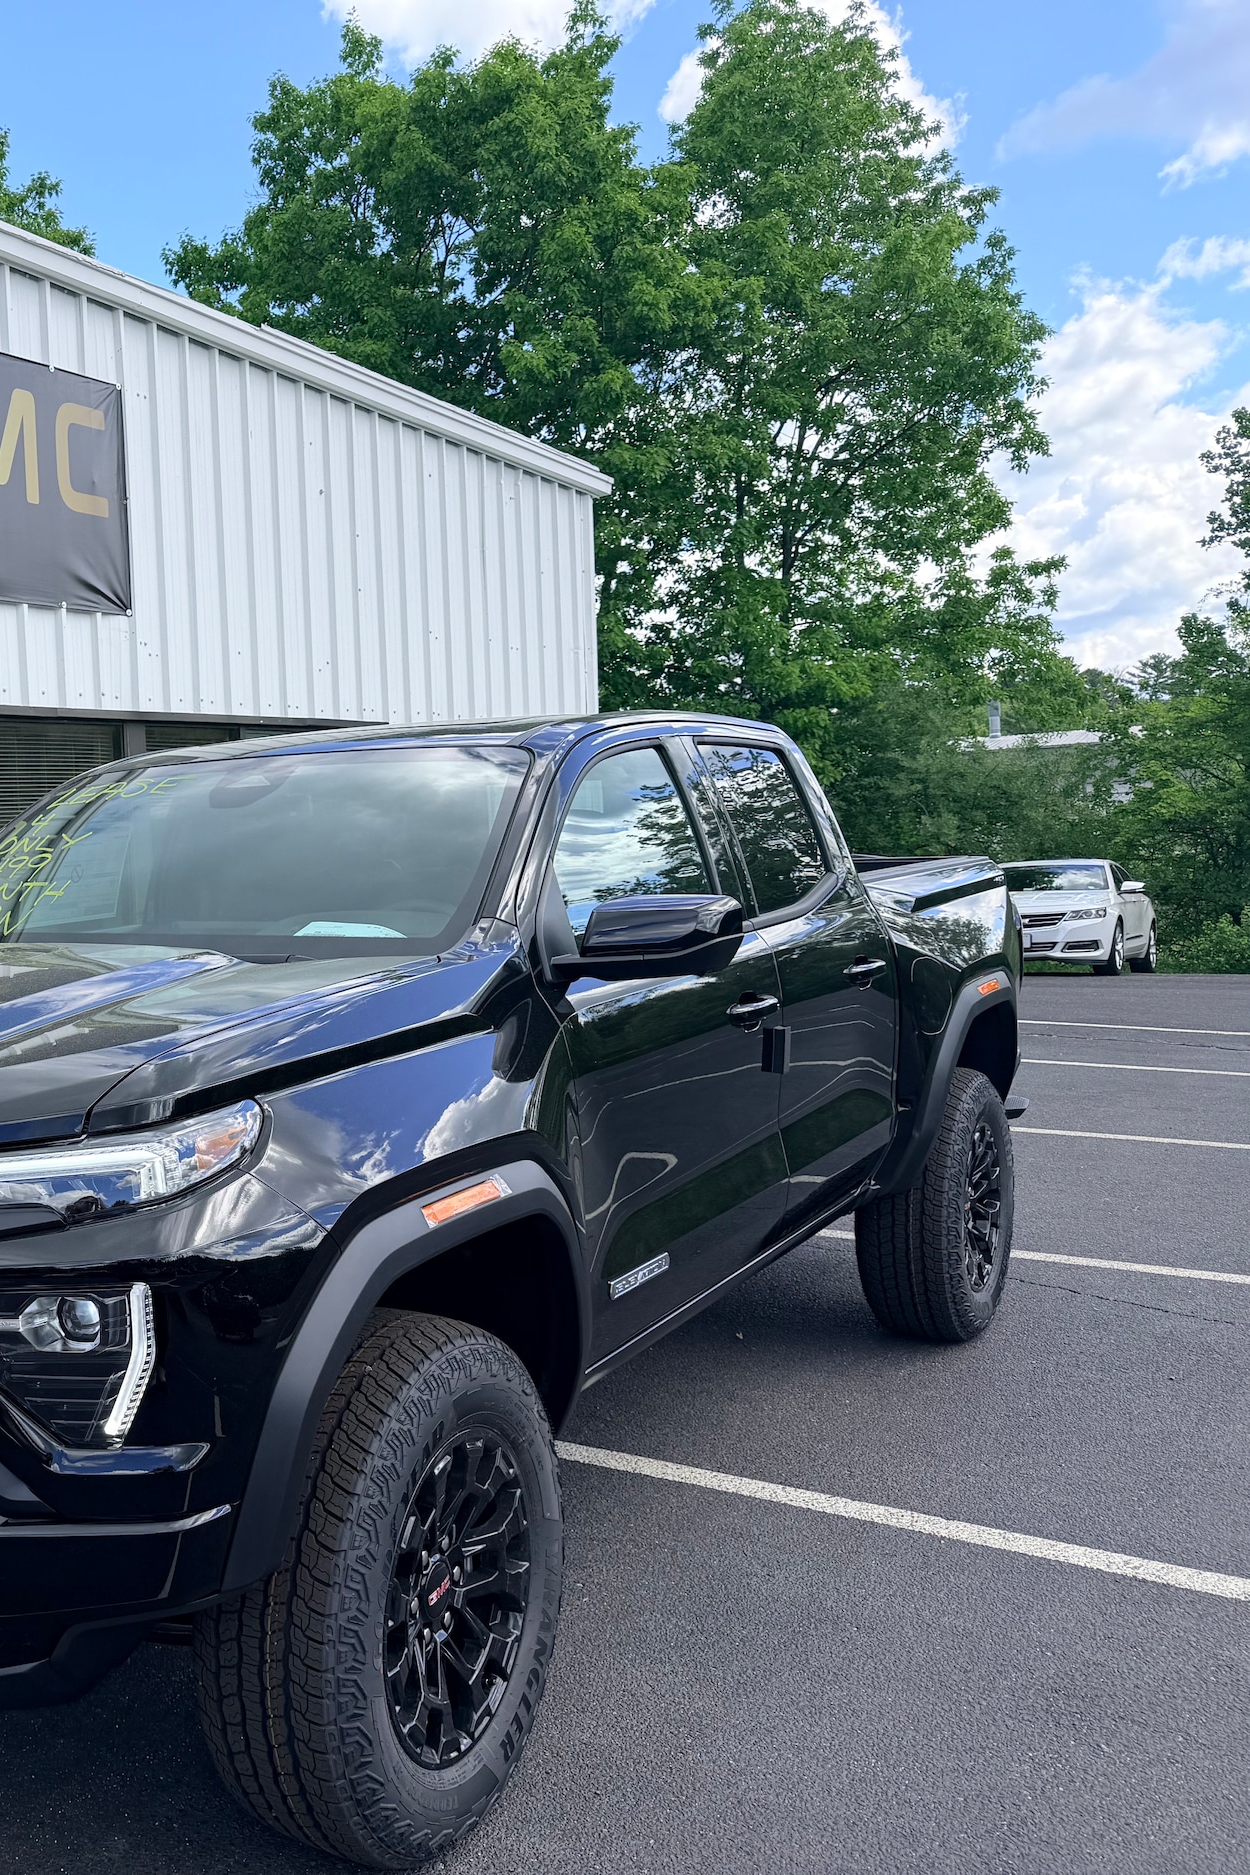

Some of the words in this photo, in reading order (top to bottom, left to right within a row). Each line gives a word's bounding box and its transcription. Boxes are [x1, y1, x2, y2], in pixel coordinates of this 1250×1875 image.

[47, 775, 197, 809] LEASE
[31, 813, 56, 837] 4
[427, 1573, 451, 1606] GMC
[498, 1538, 560, 1765] WRANGLER
